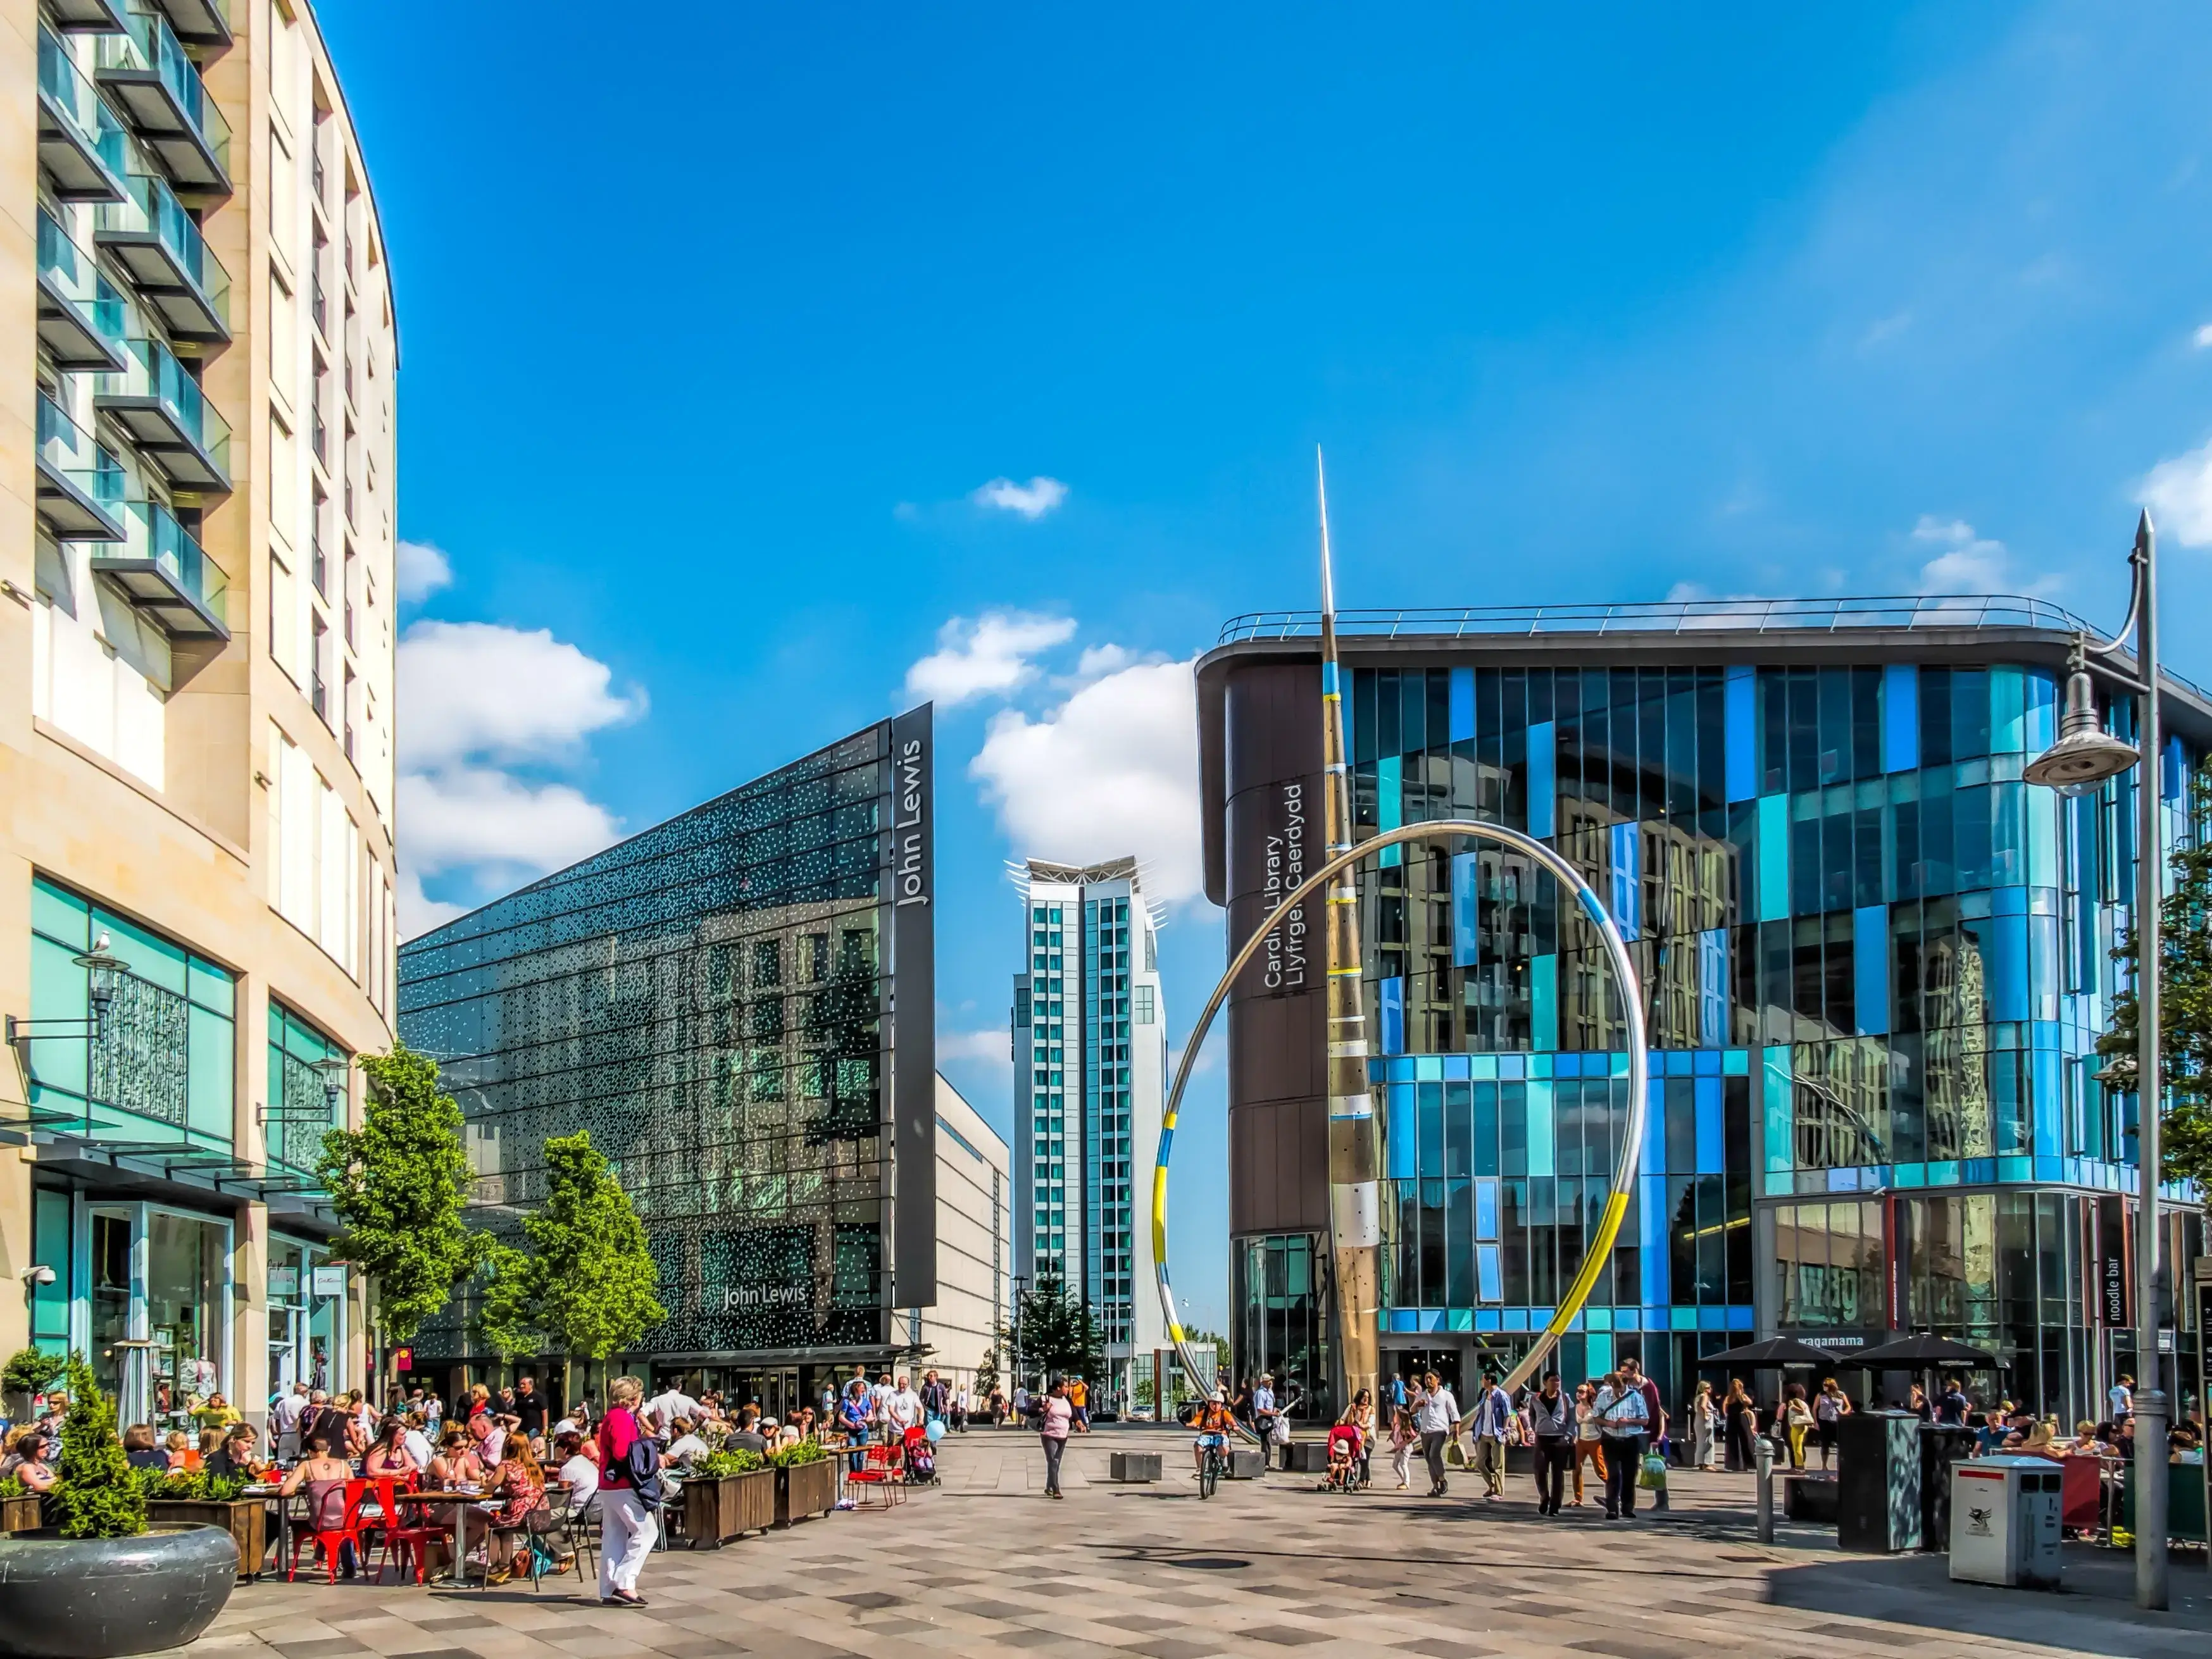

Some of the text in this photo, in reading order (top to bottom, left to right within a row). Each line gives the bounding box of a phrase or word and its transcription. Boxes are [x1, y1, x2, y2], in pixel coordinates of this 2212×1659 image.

[896, 740, 929, 906] John Lewis
[1263, 836, 1283, 988] Cardi Library
[1284, 785, 1306, 985] Llyfrge Caerdydd
[722, 1283, 806, 1312] John Lewis
[2106, 1257, 2120, 1320] noodle bar
[1797, 1338, 1863, 1348] wagamama
